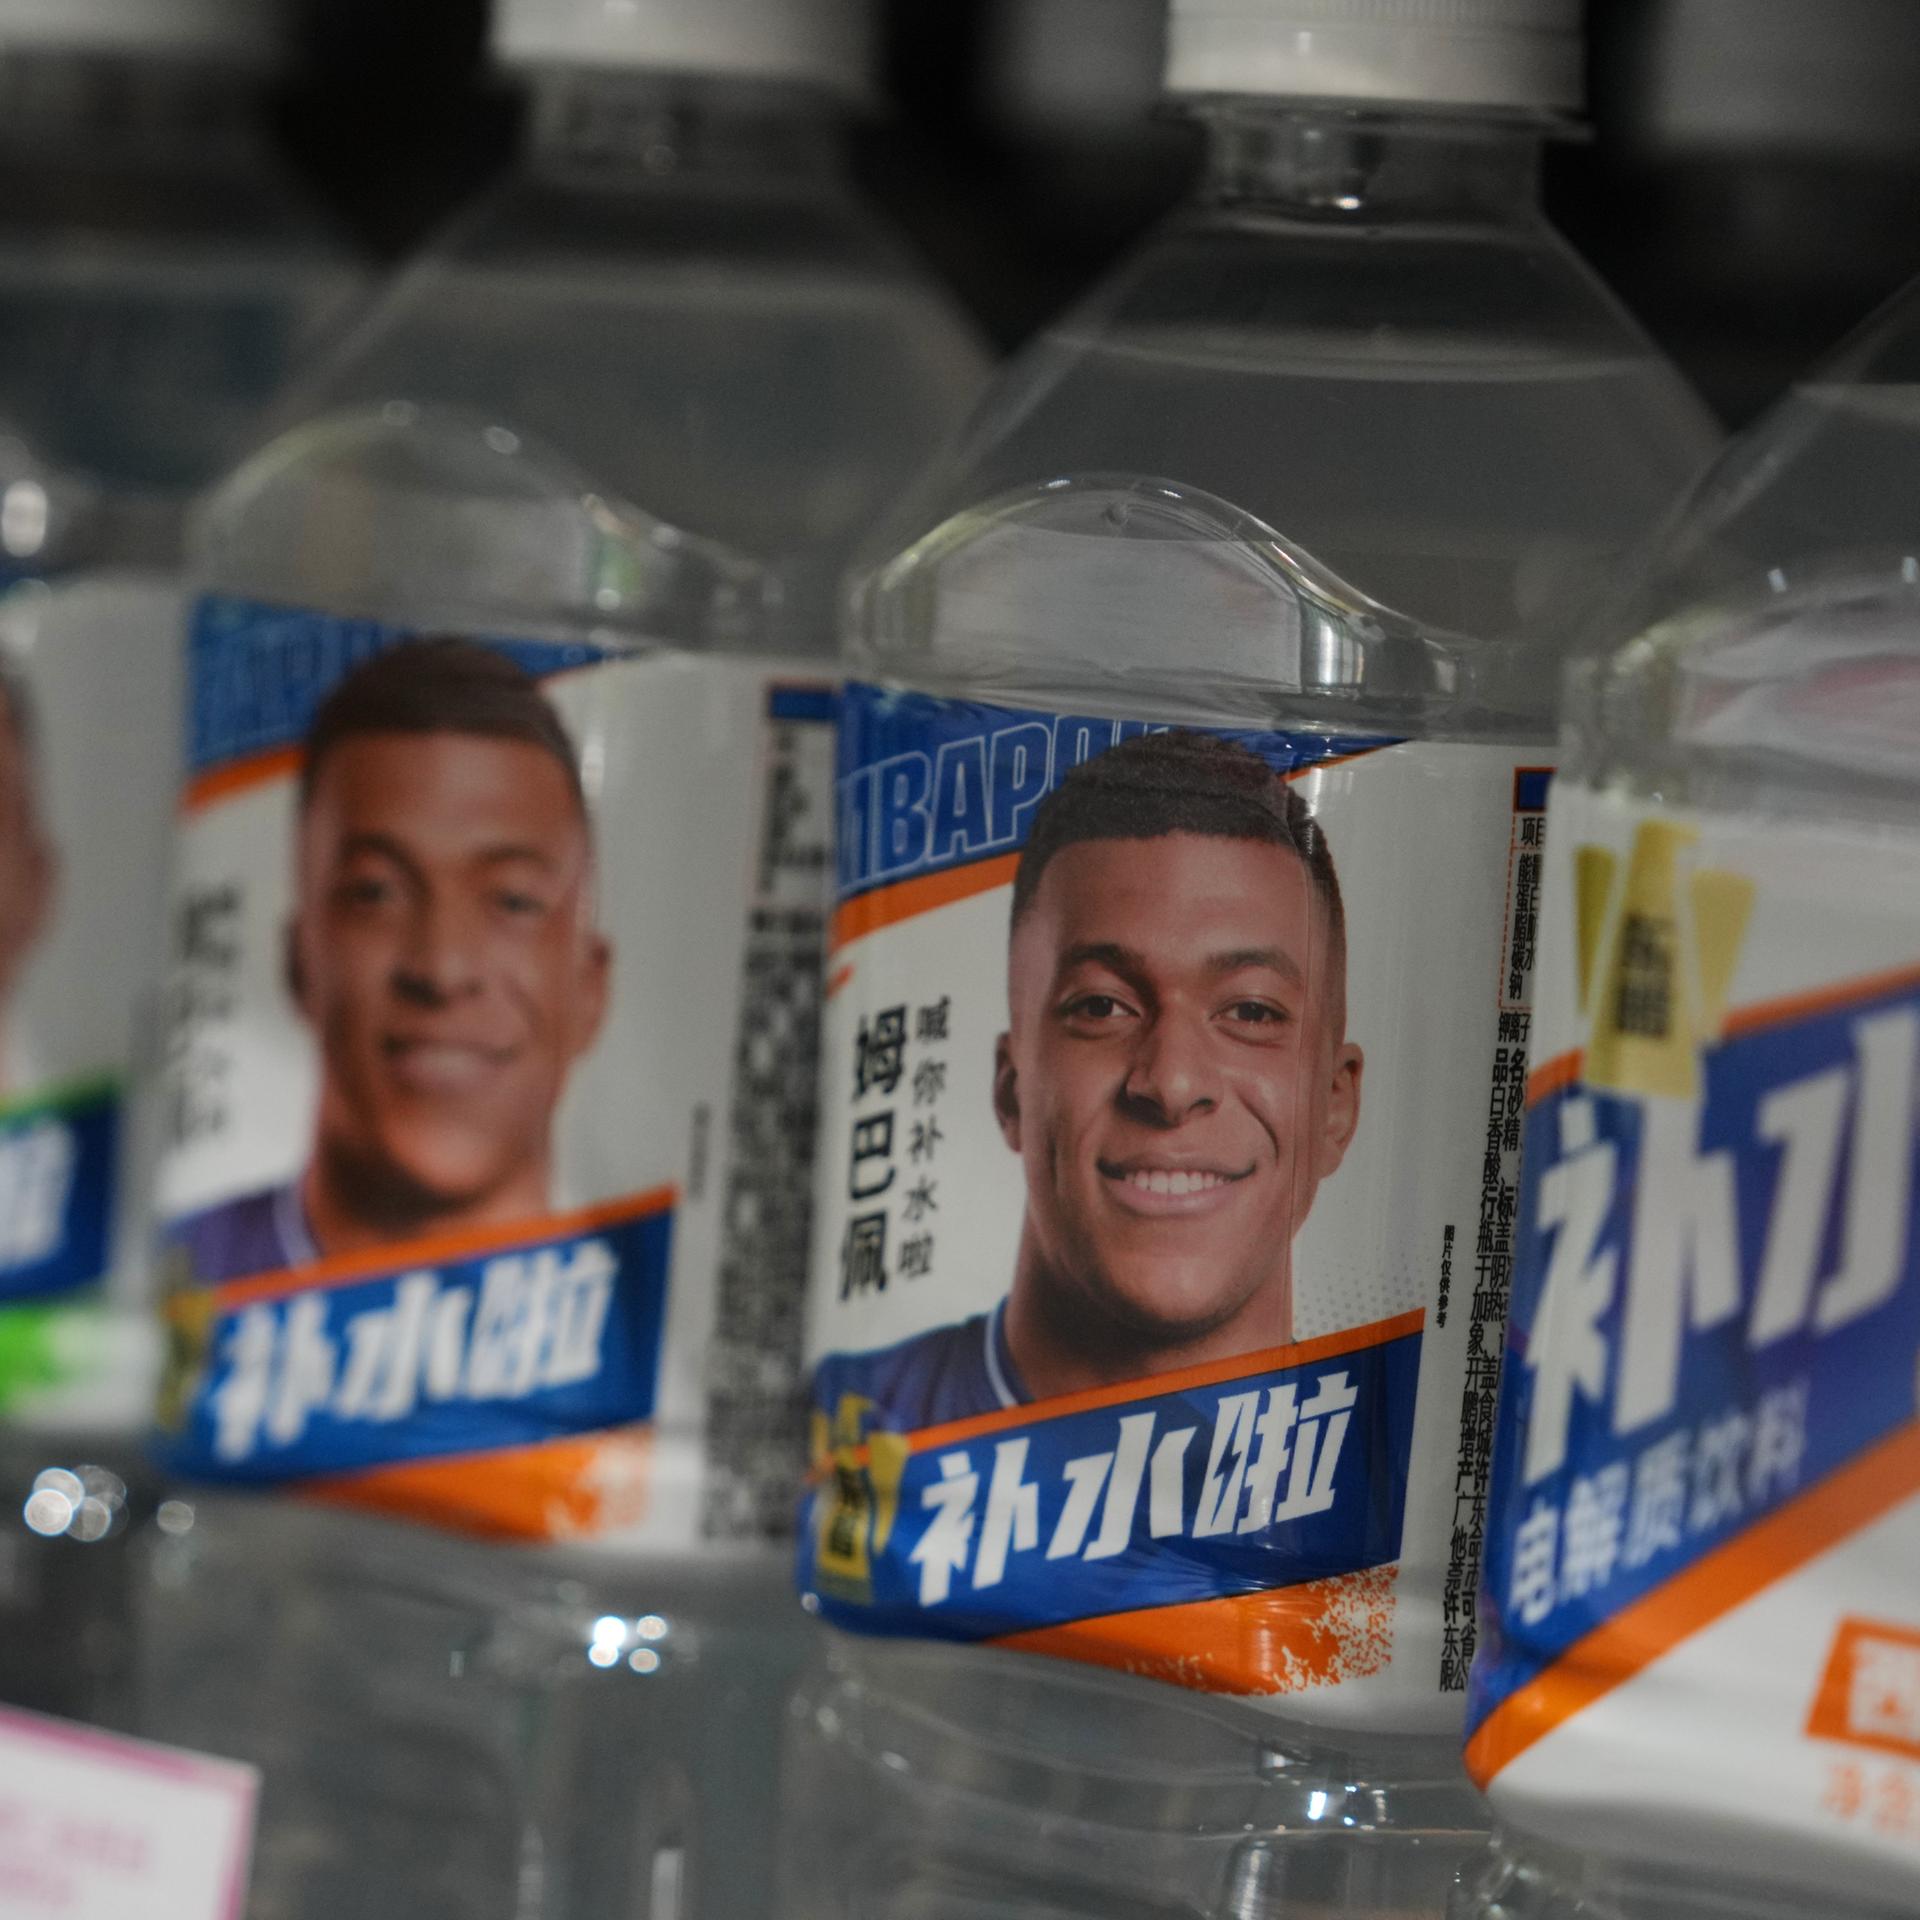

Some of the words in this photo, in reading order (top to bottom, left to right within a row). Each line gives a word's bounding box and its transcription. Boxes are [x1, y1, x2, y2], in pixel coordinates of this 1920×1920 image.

[1492, 1048, 1525, 1083] 品名
[1480, 1182, 1519, 1222] 行标
[1470, 1286, 1508, 1322] 加热
[212, 1240, 618, 1462] 补水啦
[909, 1370, 1359, 1608] 补水啦
